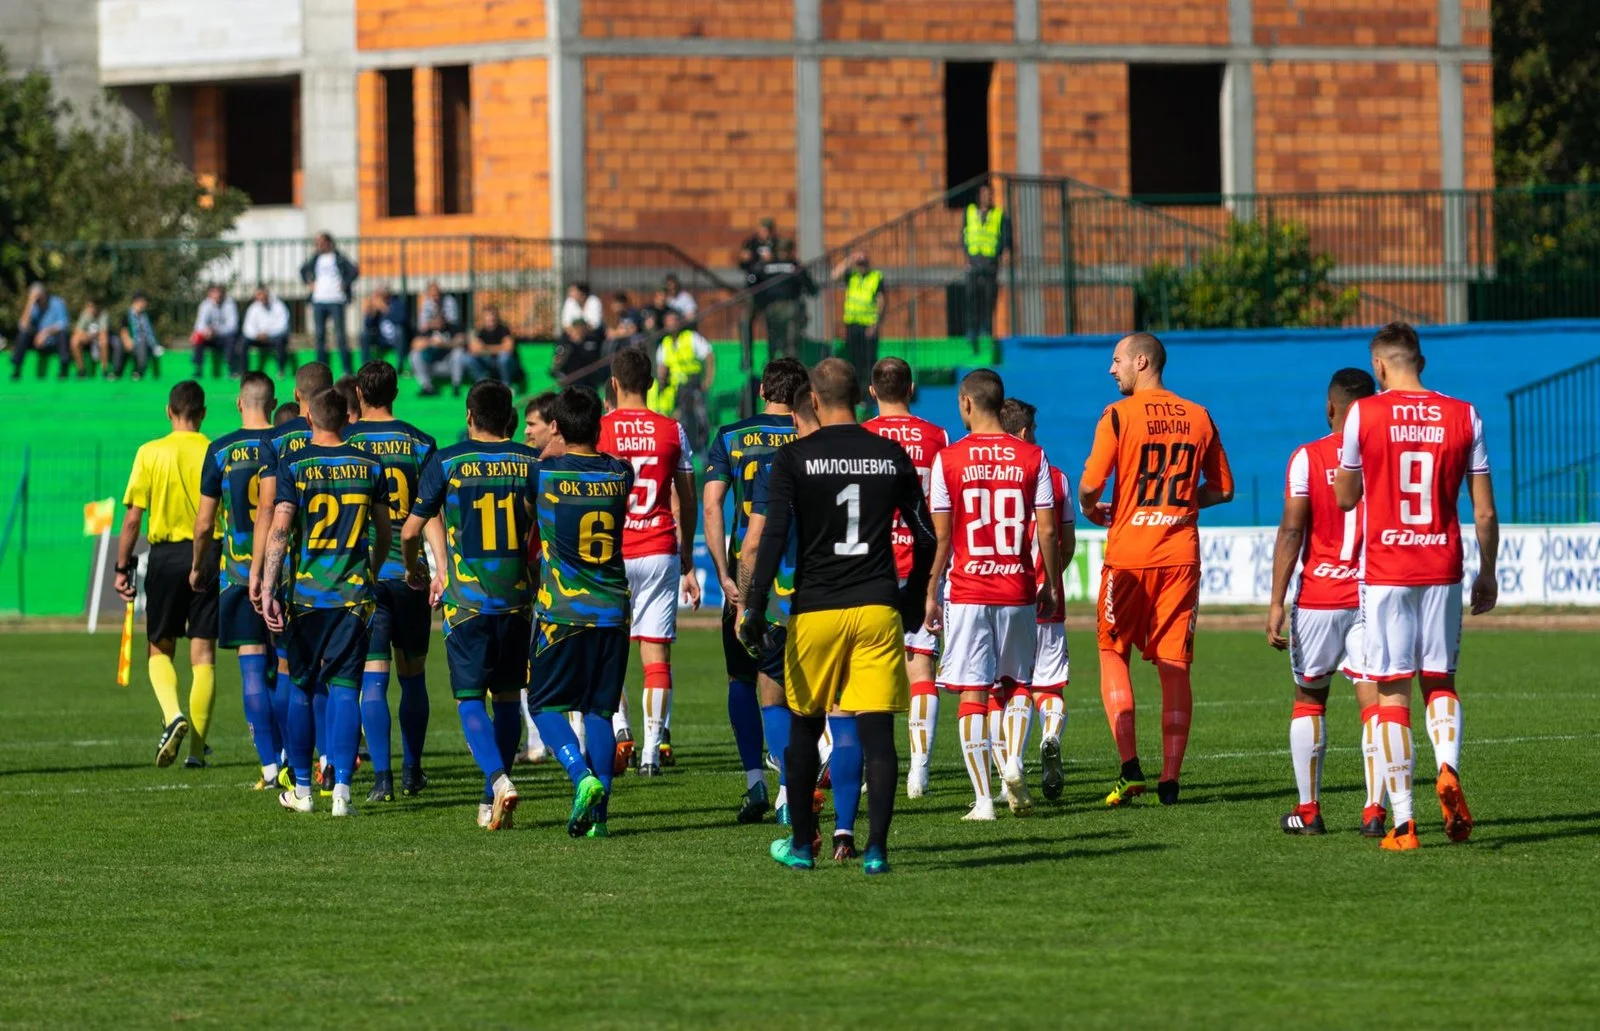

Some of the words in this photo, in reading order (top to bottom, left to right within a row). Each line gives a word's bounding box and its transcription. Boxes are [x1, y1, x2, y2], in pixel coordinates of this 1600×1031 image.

[1143, 401, 1187, 417] mts
[1392, 401, 1442, 421] mts
[614, 418, 656, 434] mts
[879, 424, 922, 442] mts
[1390, 425, 1445, 443] ПАВКОВ
[370, 440, 411, 455] ЗЕМУН
[616, 436, 656, 452] БАБИЋ
[744, 432, 763, 447] ФК
[767, 433, 799, 447] ЗЕМ
[231, 447, 250, 462] ФК
[968, 443, 1016, 461] mts
[305, 465, 324, 480] ФК
[327, 465, 368, 480] ЗЕМУН
[461, 461, 482, 477] ФК
[485, 461, 528, 478] ЗЕМУН
[805, 458, 897, 475] МИЛОШЕВИЋ
[1137, 442, 1196, 507] 82
[559, 480, 581, 496] ФК
[585, 481, 626, 497] ЗЕМУН
[1399, 451, 1434, 525] 9
[308, 492, 369, 550] 27
[472, 491, 519, 551] 11
[834, 483, 869, 556] 1
[962, 487, 1026, 557] 28
[578, 510, 616, 565] 6
